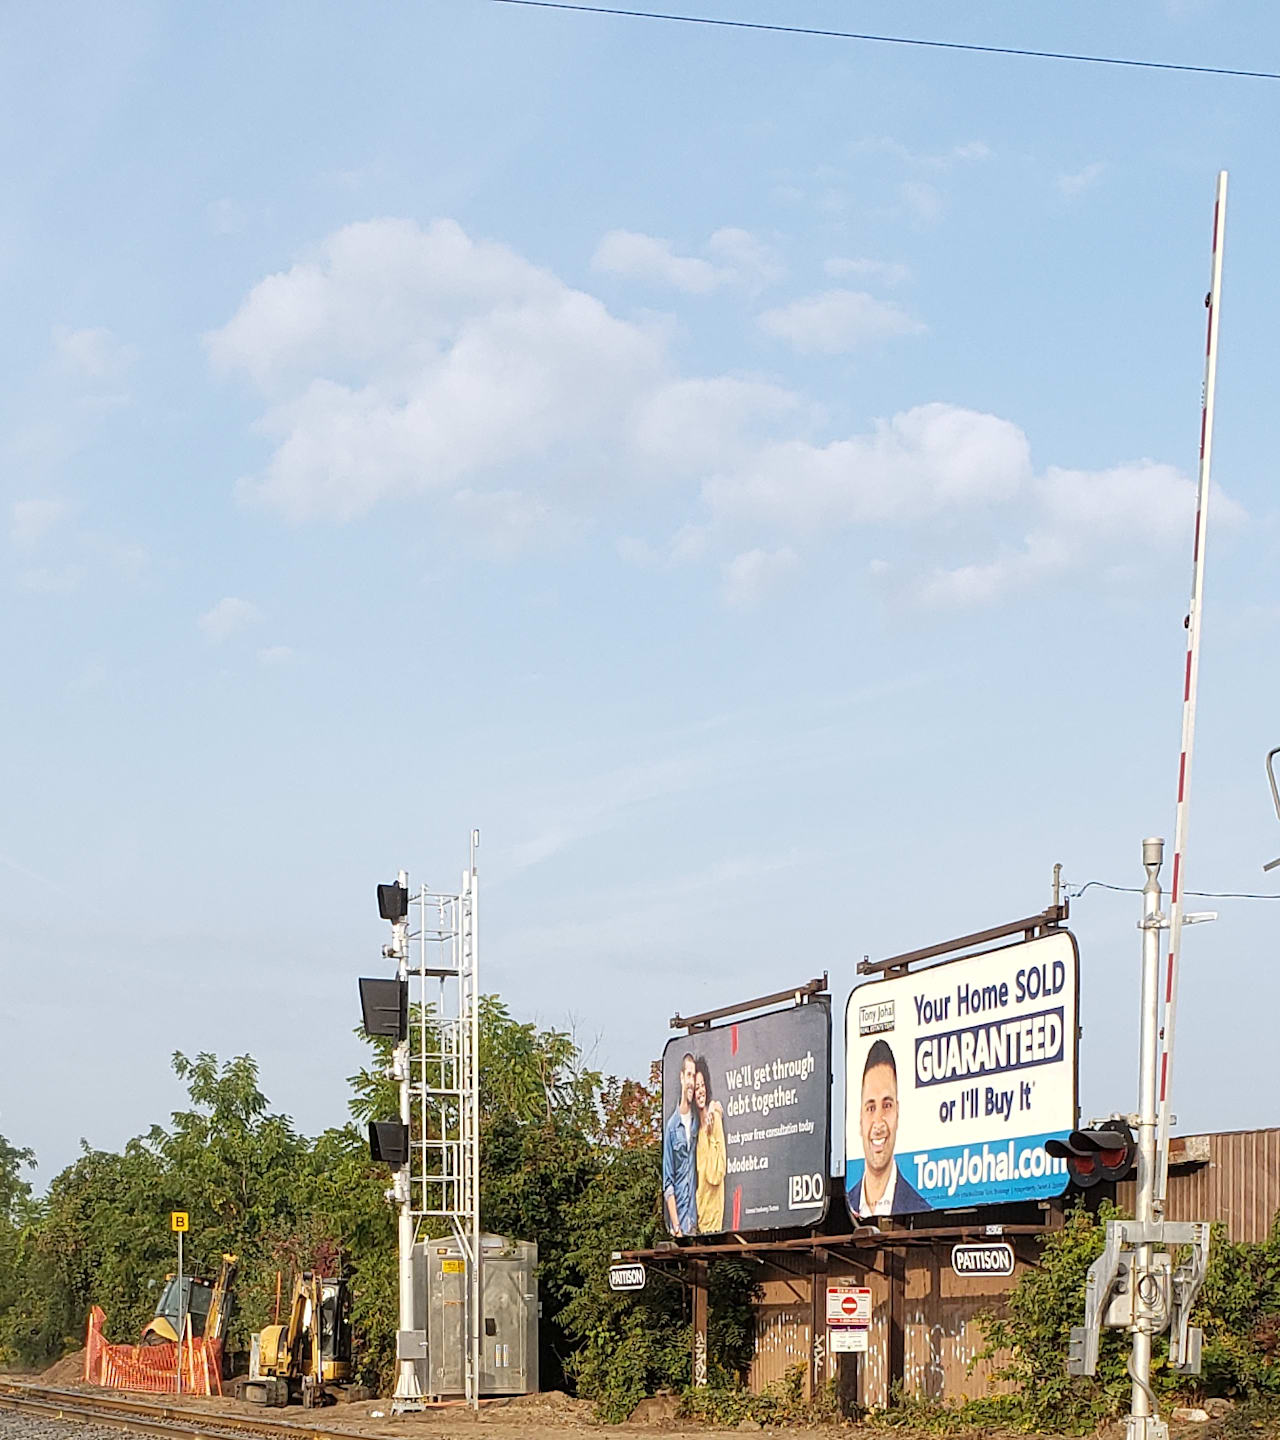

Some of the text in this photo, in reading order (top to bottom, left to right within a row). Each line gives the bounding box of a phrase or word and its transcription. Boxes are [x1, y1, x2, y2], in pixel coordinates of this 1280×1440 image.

[914, 960, 1065, 1026] Your Home SOLD
[916, 1012, 1062, 1083] GUARANTEED
[725, 1051, 815, 1090] We'll get through
[727, 1085, 799, 1117] debt together.
[939, 1100, 956, 1123] or
[961, 1087, 979, 1120] I'll
[985, 1087, 1014, 1122] Buy
[741, 1131, 753, 1146] your
[754, 1128, 766, 1140] free
[766, 1122, 798, 1138] consultation
[799, 1119, 815, 1134] today
[727, 1154, 769, 1174] bdodebt.ca
[914, 1140, 1068, 1196] TonyJohal.com
[792, 1173, 824, 1202] BDO
[176, 1216, 185, 1227] B
[956, 1250, 1010, 1270] PATTISON
[611, 1269, 643, 1285] PATTISON
